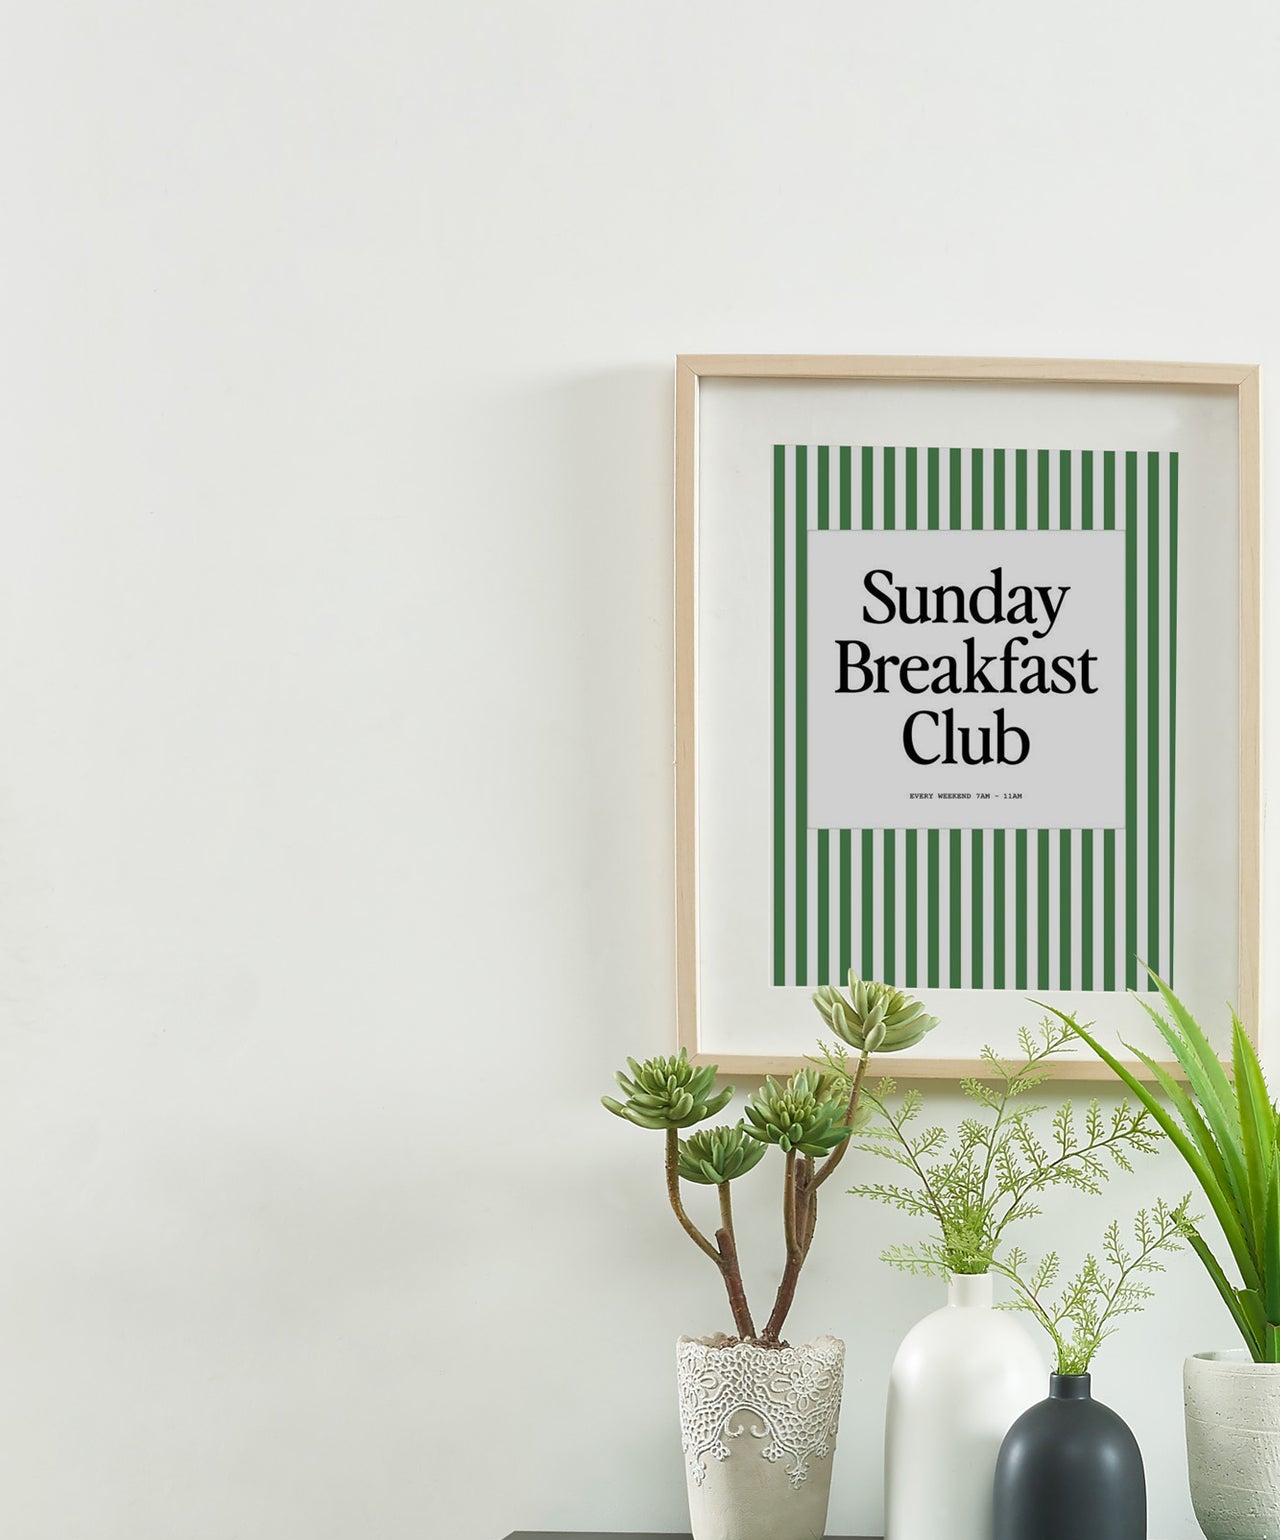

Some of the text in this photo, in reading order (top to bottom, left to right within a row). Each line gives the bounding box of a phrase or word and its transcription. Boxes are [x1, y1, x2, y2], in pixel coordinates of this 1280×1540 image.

[862, 566, 1072, 639] Sunday
[834, 636, 1099, 695] Breakfast
[902, 707, 1031, 766] Club
[909, 792, 934, 800] EVERY
[937, 792, 972, 800] WEEKEND
[975, 792, 991, 800] 7AM
[1003, 792, 1023, 800] 11AM
